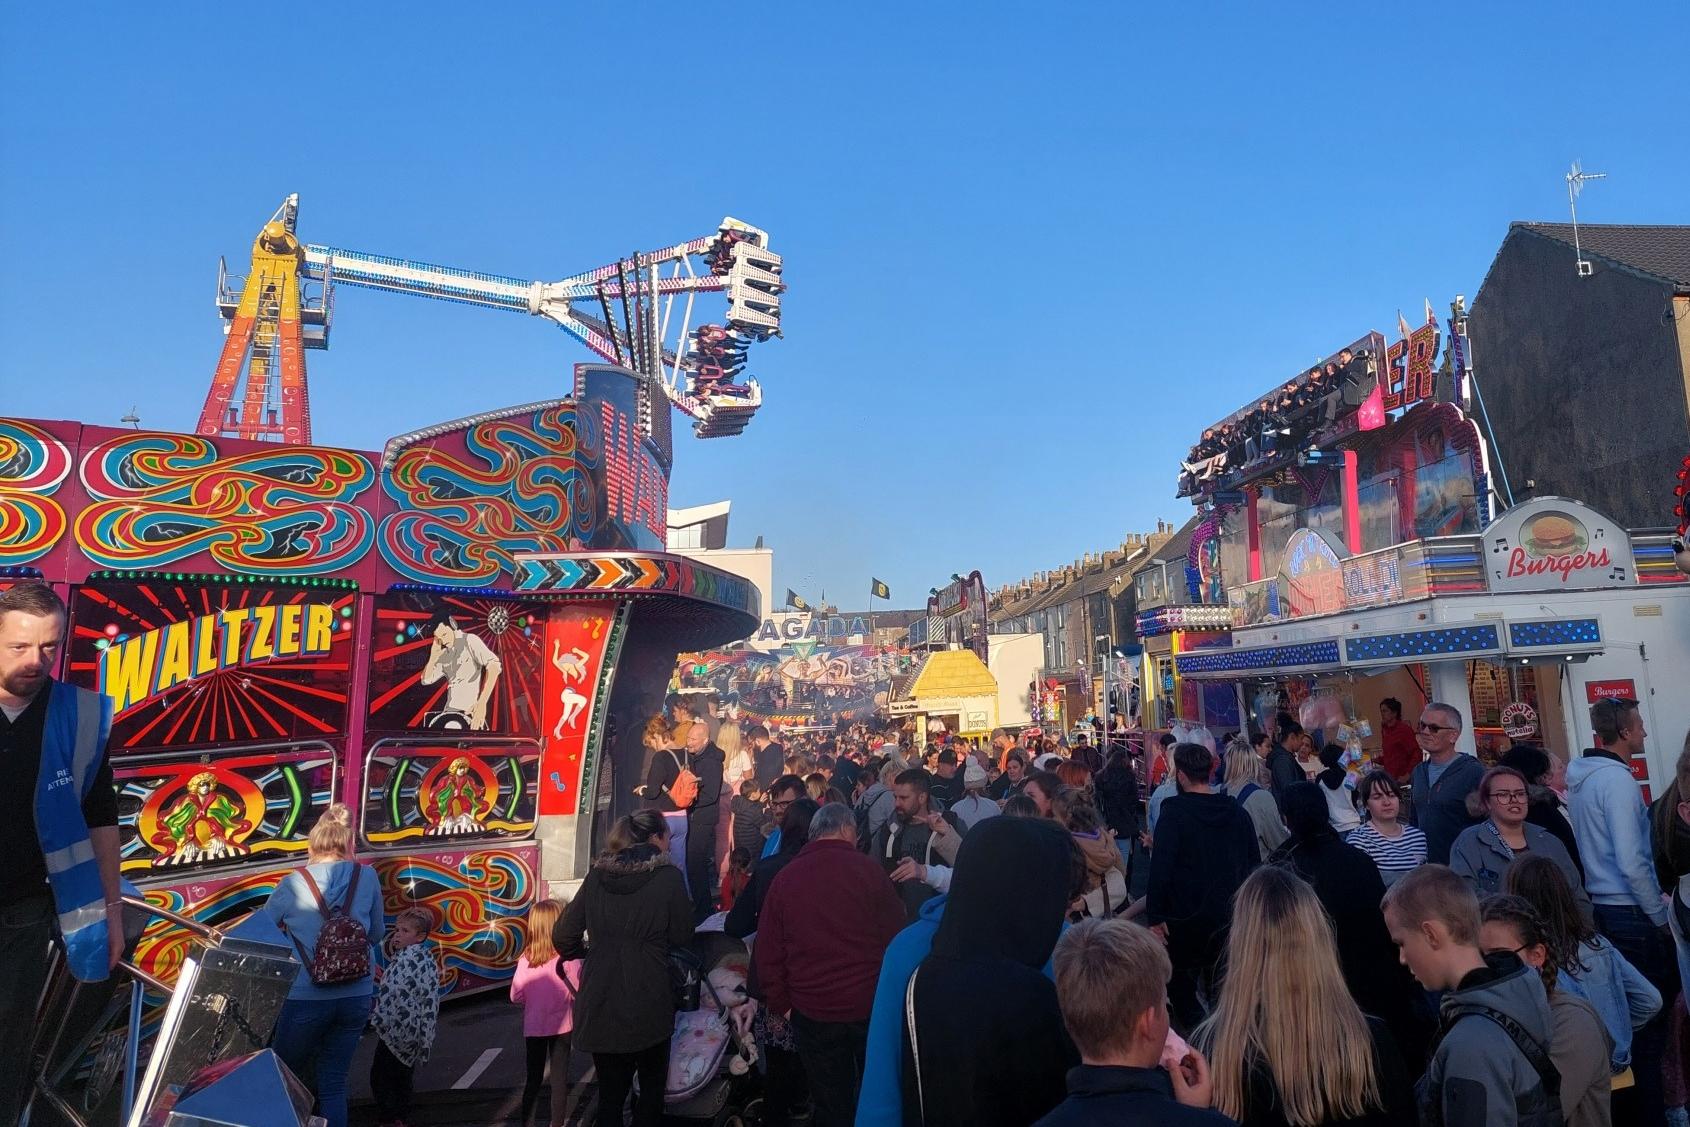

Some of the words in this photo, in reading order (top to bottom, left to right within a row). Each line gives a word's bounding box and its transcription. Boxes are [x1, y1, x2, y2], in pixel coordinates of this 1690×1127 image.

[1383, 324, 1435, 411] ER
[1507, 547, 1611, 582] Burgers
[757, 616, 870, 641] AGADA
[99, 604, 336, 717] WALTZER
[1594, 686, 1629, 698] Burgers
[1502, 703, 1535, 723] DONUTS
[1506, 727, 1533, 736] nutella
[56, 768, 71, 778] RI
